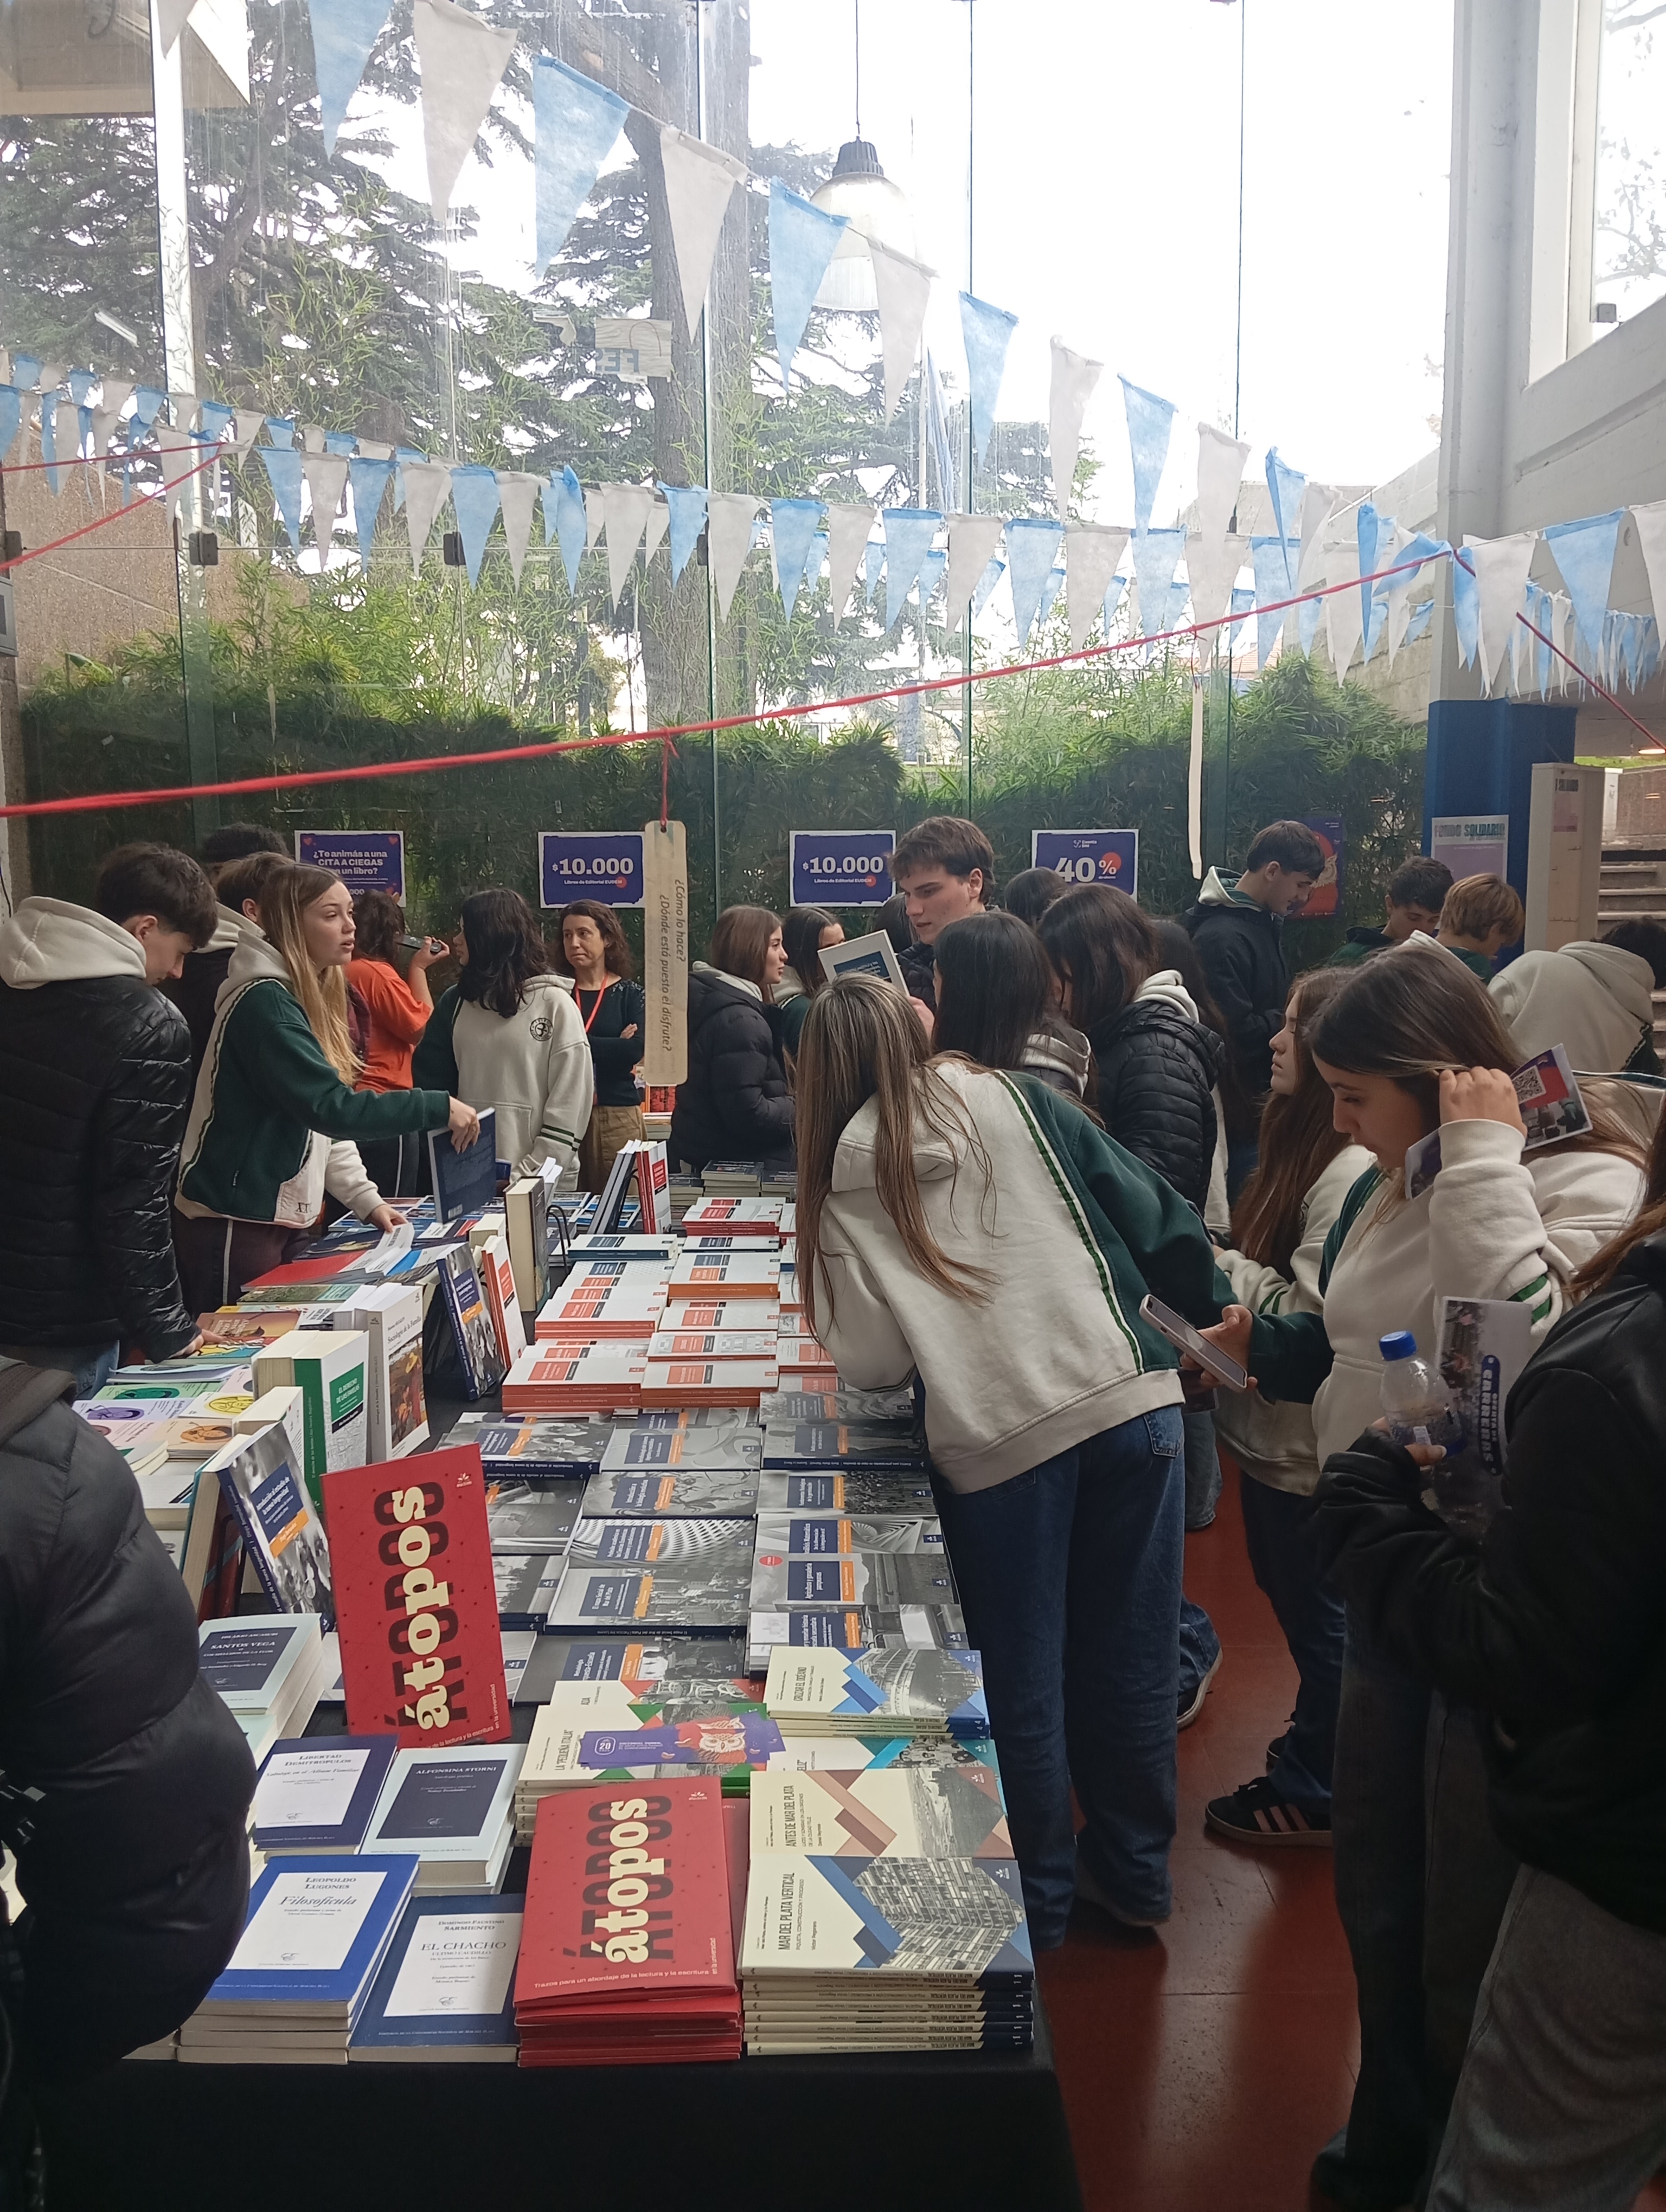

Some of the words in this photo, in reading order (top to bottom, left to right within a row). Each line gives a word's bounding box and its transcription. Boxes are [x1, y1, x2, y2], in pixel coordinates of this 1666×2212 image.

[331, 850, 363, 858] animás
[675, 879, 685, 916] ¿Cómo
[659, 895, 671, 934] ¿Dónde
[676, 918, 686, 929] lo
[661, 936, 671, 957] está
[676, 931, 687, 962] hace?
[659, 960, 671, 994] puesto
[662, 996, 672, 1005] el
[660, 1007, 672, 1052] disfrute?
[387, 1330, 403, 1344] Sociología
[411, 1316, 422, 1327] Familia
[343, 1378, 357, 1392] DERECHO
[347, 1384, 360, 1397] FAVELAS
[1481, 1369, 1493, 1462] CARRERAS
[392, 1486, 450, 1730] átopos
[490, 1683, 498, 1715] universidad
[445, 1735, 463, 1745] lectura
[472, 1726, 494, 1737] escritura
[599, 1742, 611, 1750] 20
[783, 1785, 794, 1801] PLATA
[784, 1801, 795, 1810] DEL
[784, 1810, 796, 1822] MAR
[785, 1831, 797, 1847] ANTES
[591, 1798, 664, 1963] átopos
[781, 1873, 795, 1900] VERTICAL
[780, 1901, 793, 1921] PLATA
[779, 1922, 792, 1934] DEL
[421, 1943, 439, 1951] EL
[443, 1941, 508, 1950] CHACHO
[778, 1935, 791, 1950] MAR
[534, 1980, 558, 1989] Trazos
[587, 1973, 619, 1983] abordaje
